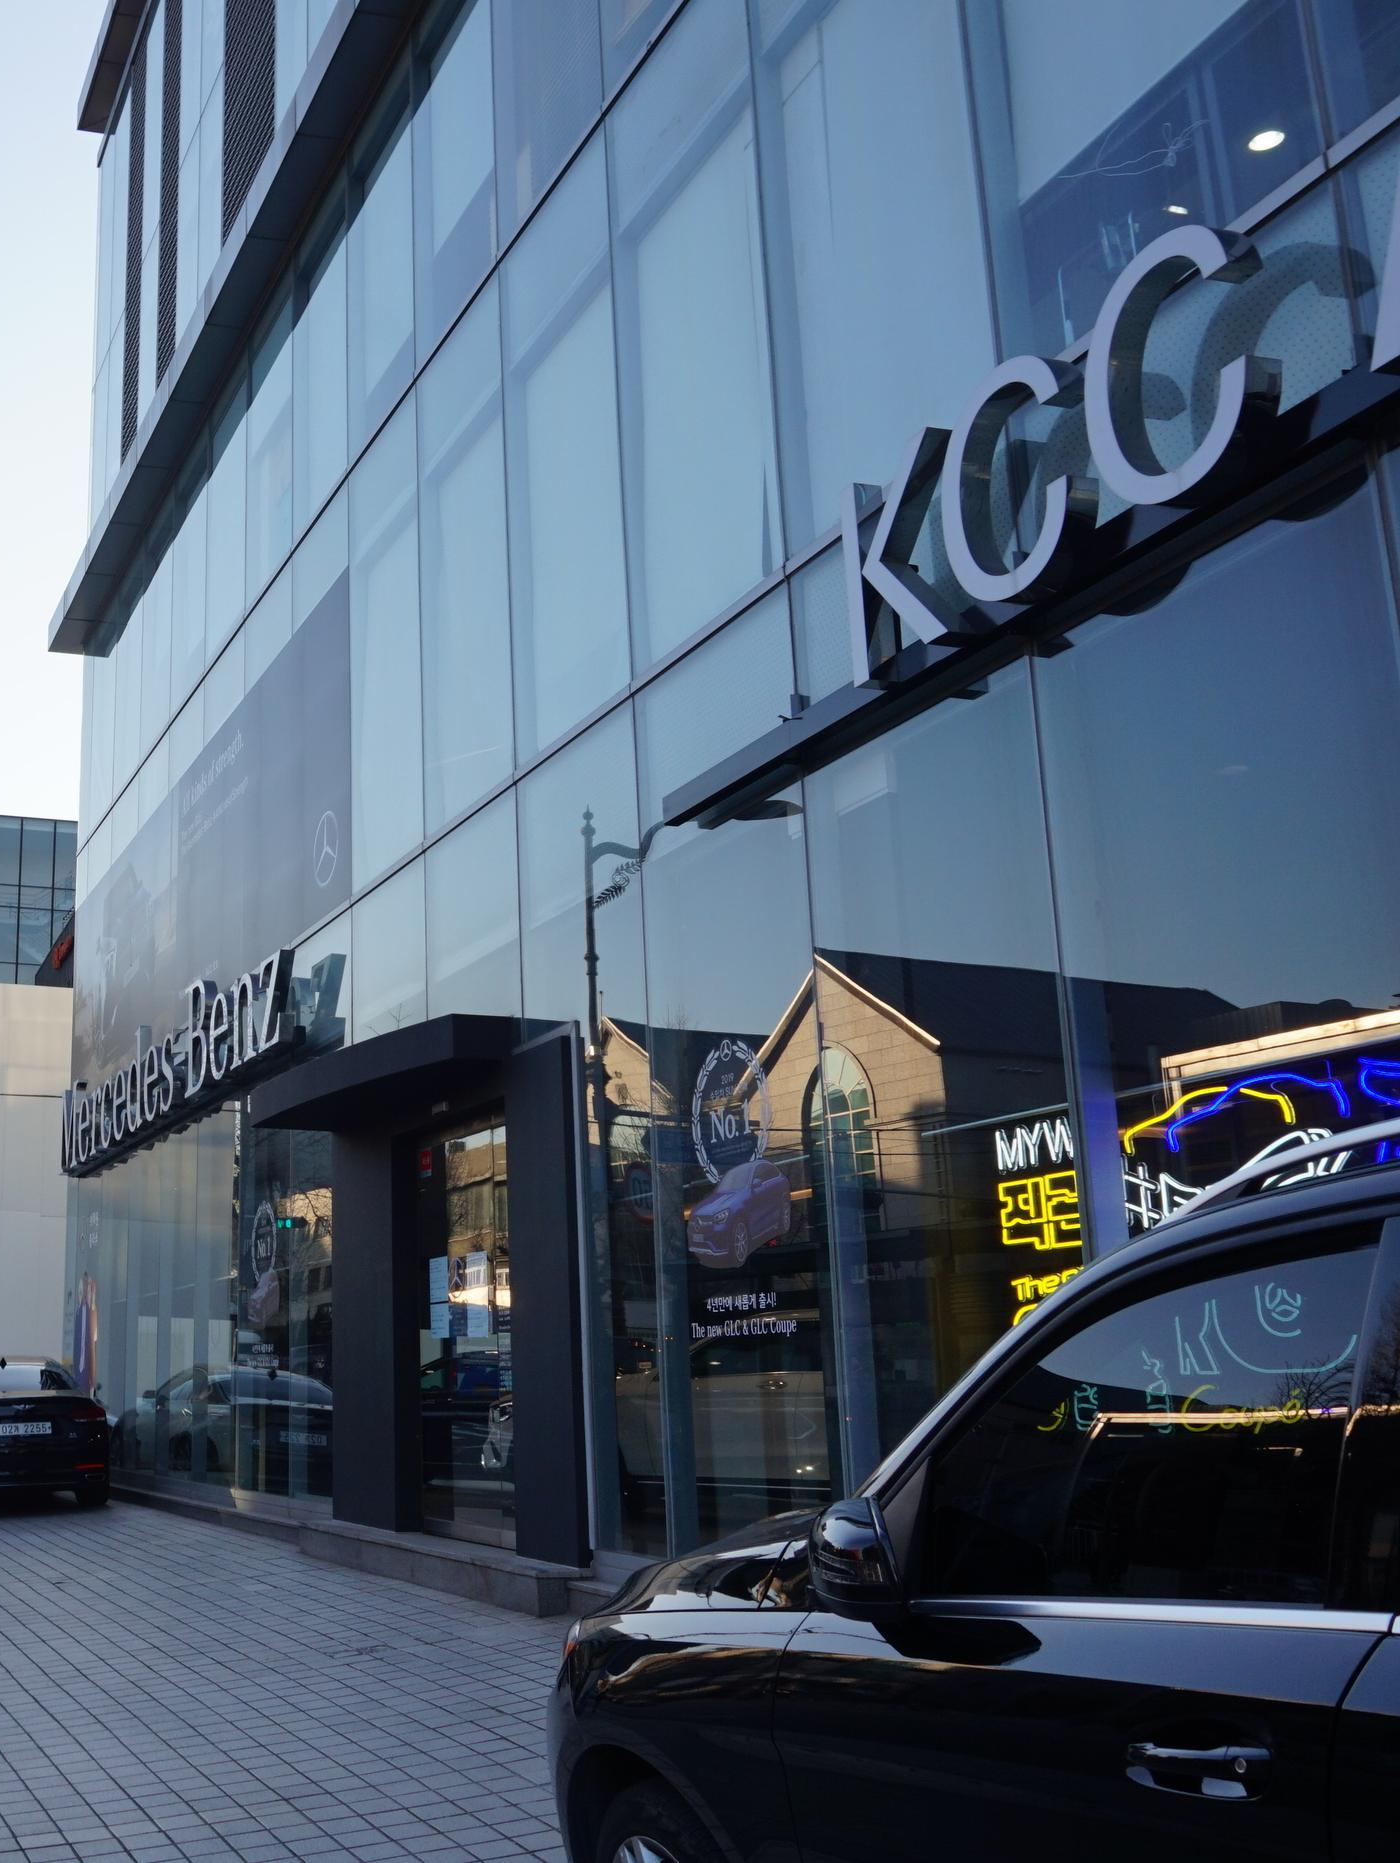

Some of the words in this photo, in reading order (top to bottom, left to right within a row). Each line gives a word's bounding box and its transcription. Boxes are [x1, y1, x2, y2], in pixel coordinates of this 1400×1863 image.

[840, 224, 1255, 689] KCC
[61, 948, 295, 1174] Mercedes-Benz
[710, 1107, 740, 1144] No.
[706, 1296, 733, 1313] 4년만에
[734, 1293, 757, 1311] 새롭게
[759, 1291, 777, 1310] 출시!
[691, 1322, 705, 1339] The
[707, 1324, 722, 1338] new
[724, 1319, 741, 1337] GLC
[742, 1319, 749, 1335] &
[750, 1318, 768, 1335] GLC
[770, 1319, 797, 1337] Coupe
[24, 1423, 47, 1433] 2255
